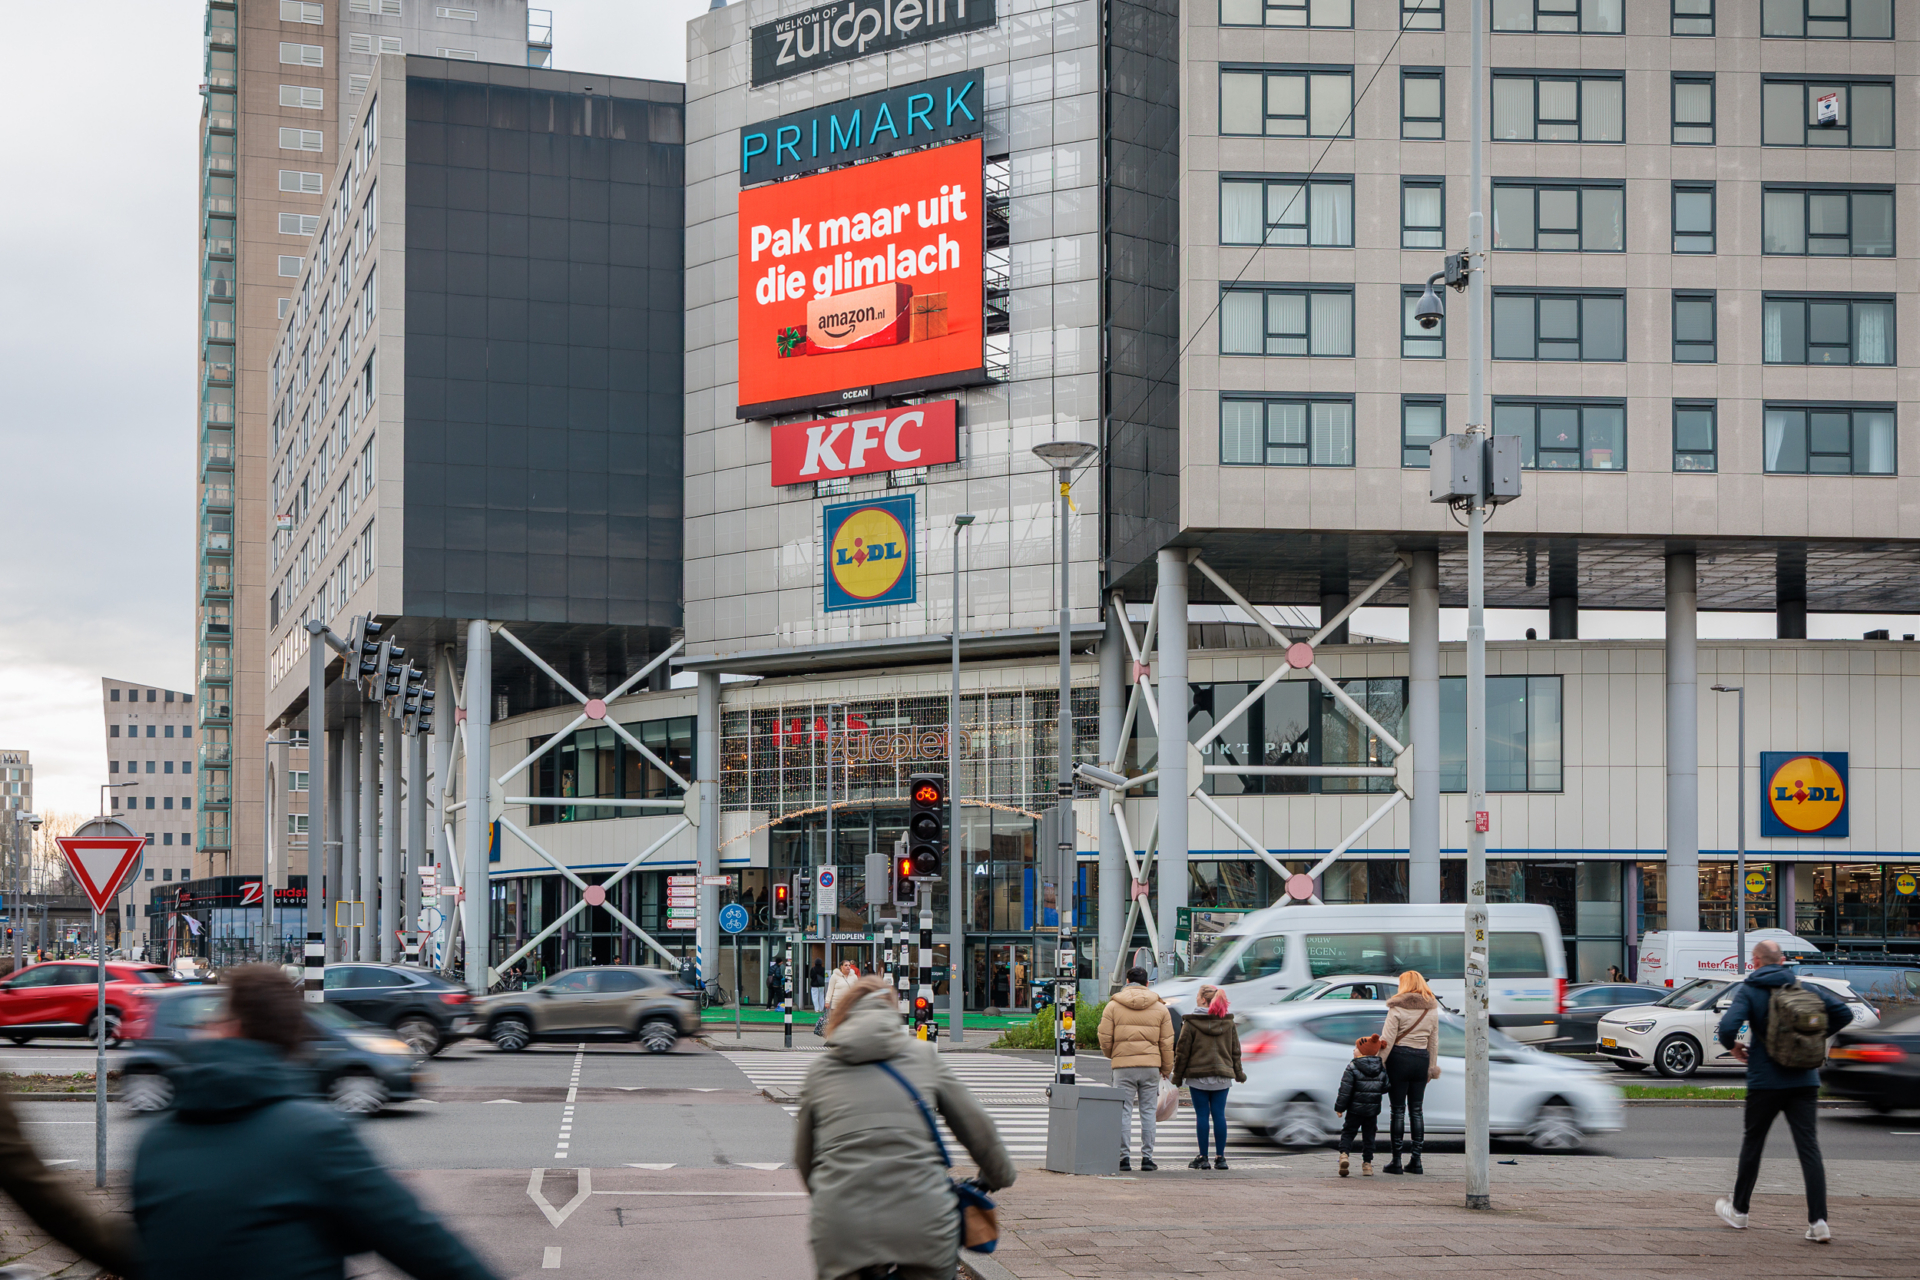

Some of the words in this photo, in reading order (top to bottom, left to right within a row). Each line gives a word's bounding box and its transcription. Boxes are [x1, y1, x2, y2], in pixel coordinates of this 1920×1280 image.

[776, 12, 820, 33] WELKOM
[822, 7, 838, 18] OP
[743, 81, 976, 173] PRIMARK
[751, 217, 813, 262] Pak
[819, 203, 911, 248] maar
[917, 184, 968, 229] uit
[756, 264, 806, 305] die
[813, 233, 960, 300] glimlach
[818, 306, 885, 330] amazon.nl
[842, 388, 869, 399] OCEAN
[799, 411, 924, 475] KFC
[825, 722, 973, 767] zuidplein
[832, 932, 865, 940] ZUIDPLEIN
[1698, 960, 1721, 969] Inter
